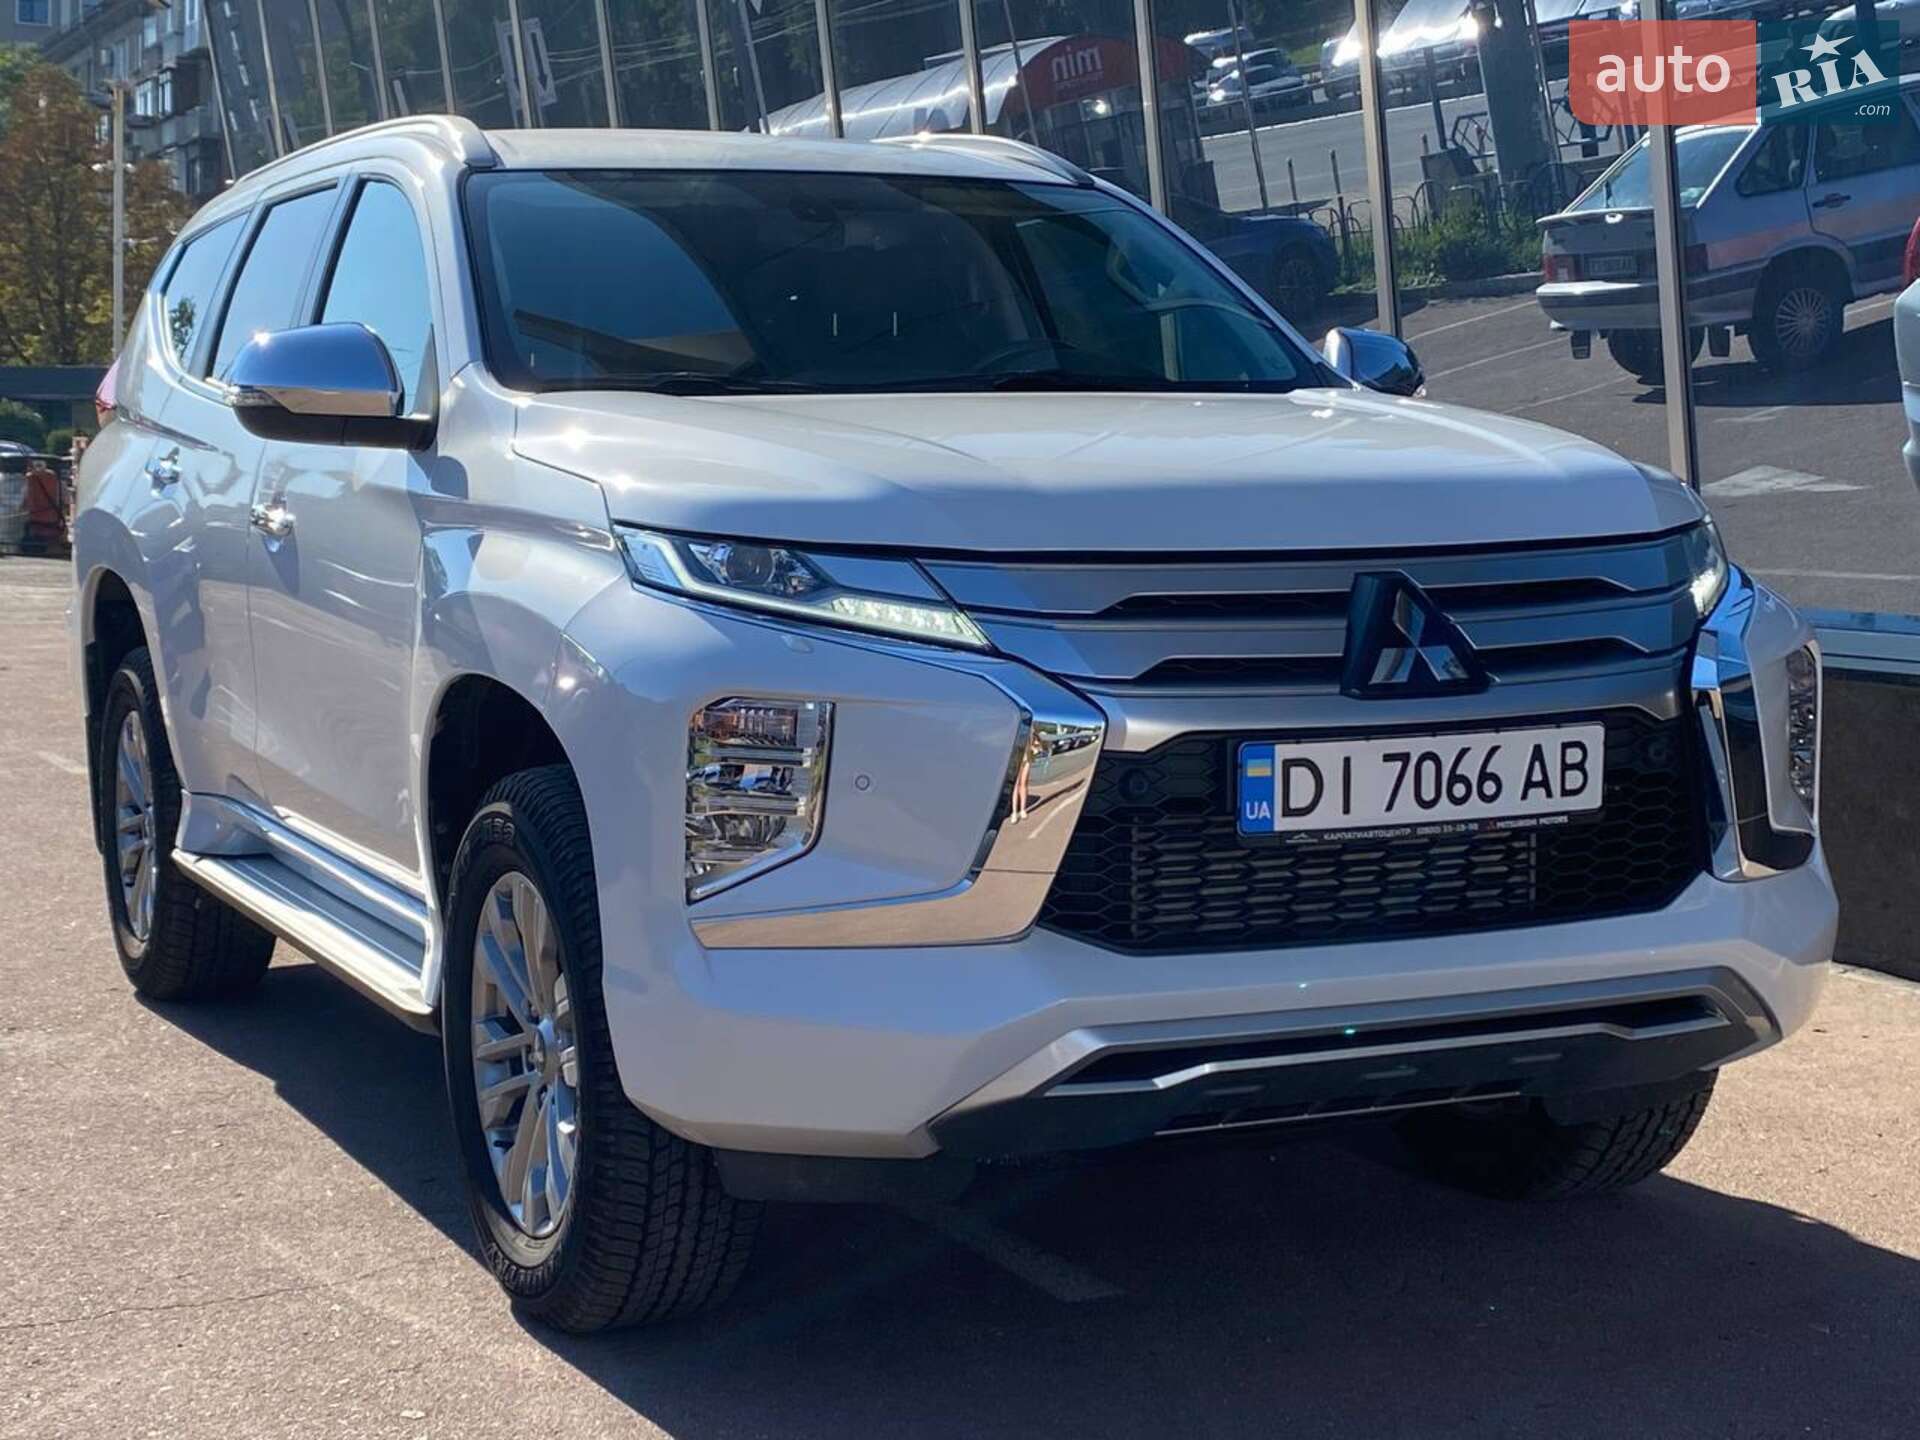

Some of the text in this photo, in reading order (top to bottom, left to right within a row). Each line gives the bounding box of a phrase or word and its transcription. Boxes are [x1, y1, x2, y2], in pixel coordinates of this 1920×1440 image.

[1382, 745, 1503, 812] 7066
[1520, 740, 1589, 801] AB
[1245, 801, 1271, 821] UA
